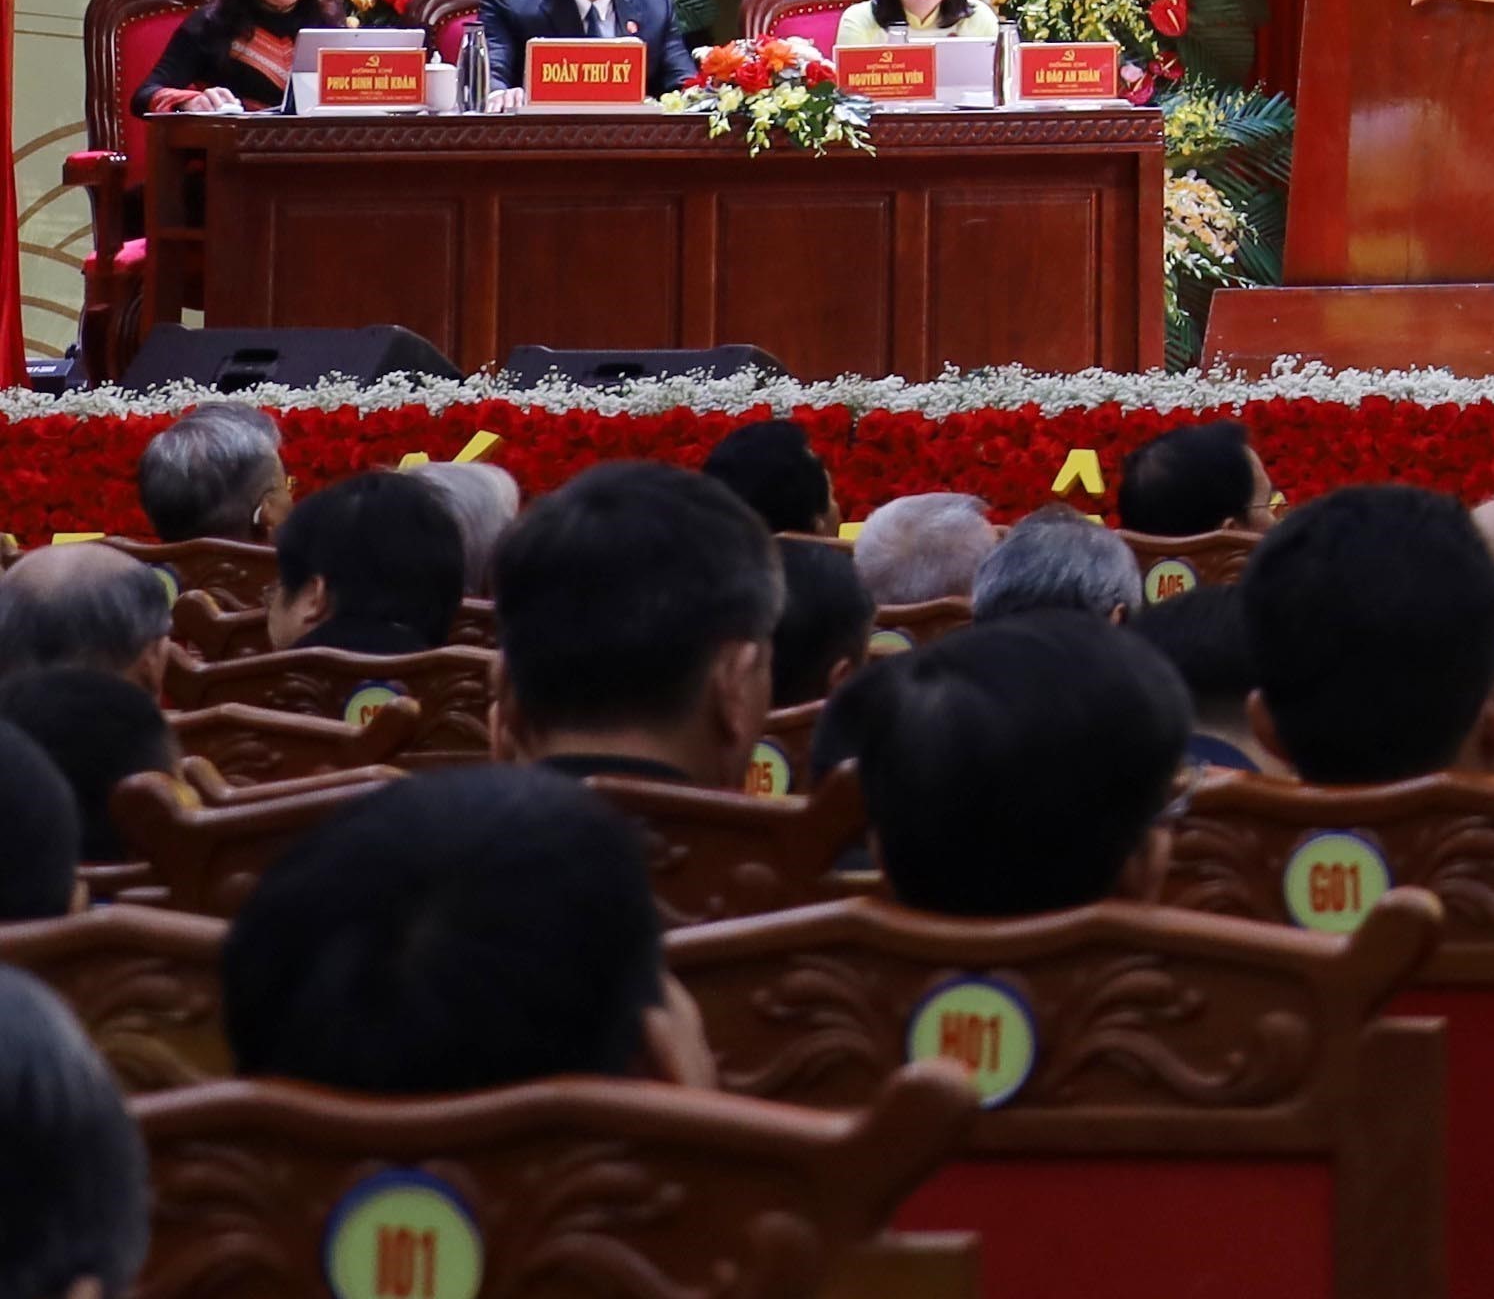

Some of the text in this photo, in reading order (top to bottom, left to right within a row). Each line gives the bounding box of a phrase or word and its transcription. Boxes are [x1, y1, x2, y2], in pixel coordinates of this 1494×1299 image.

[542, 59, 632, 82] ĐOÀN THƯ KÝ
[1157, 574, 1183, 599] A05
[1308, 862, 1363, 914] G01
